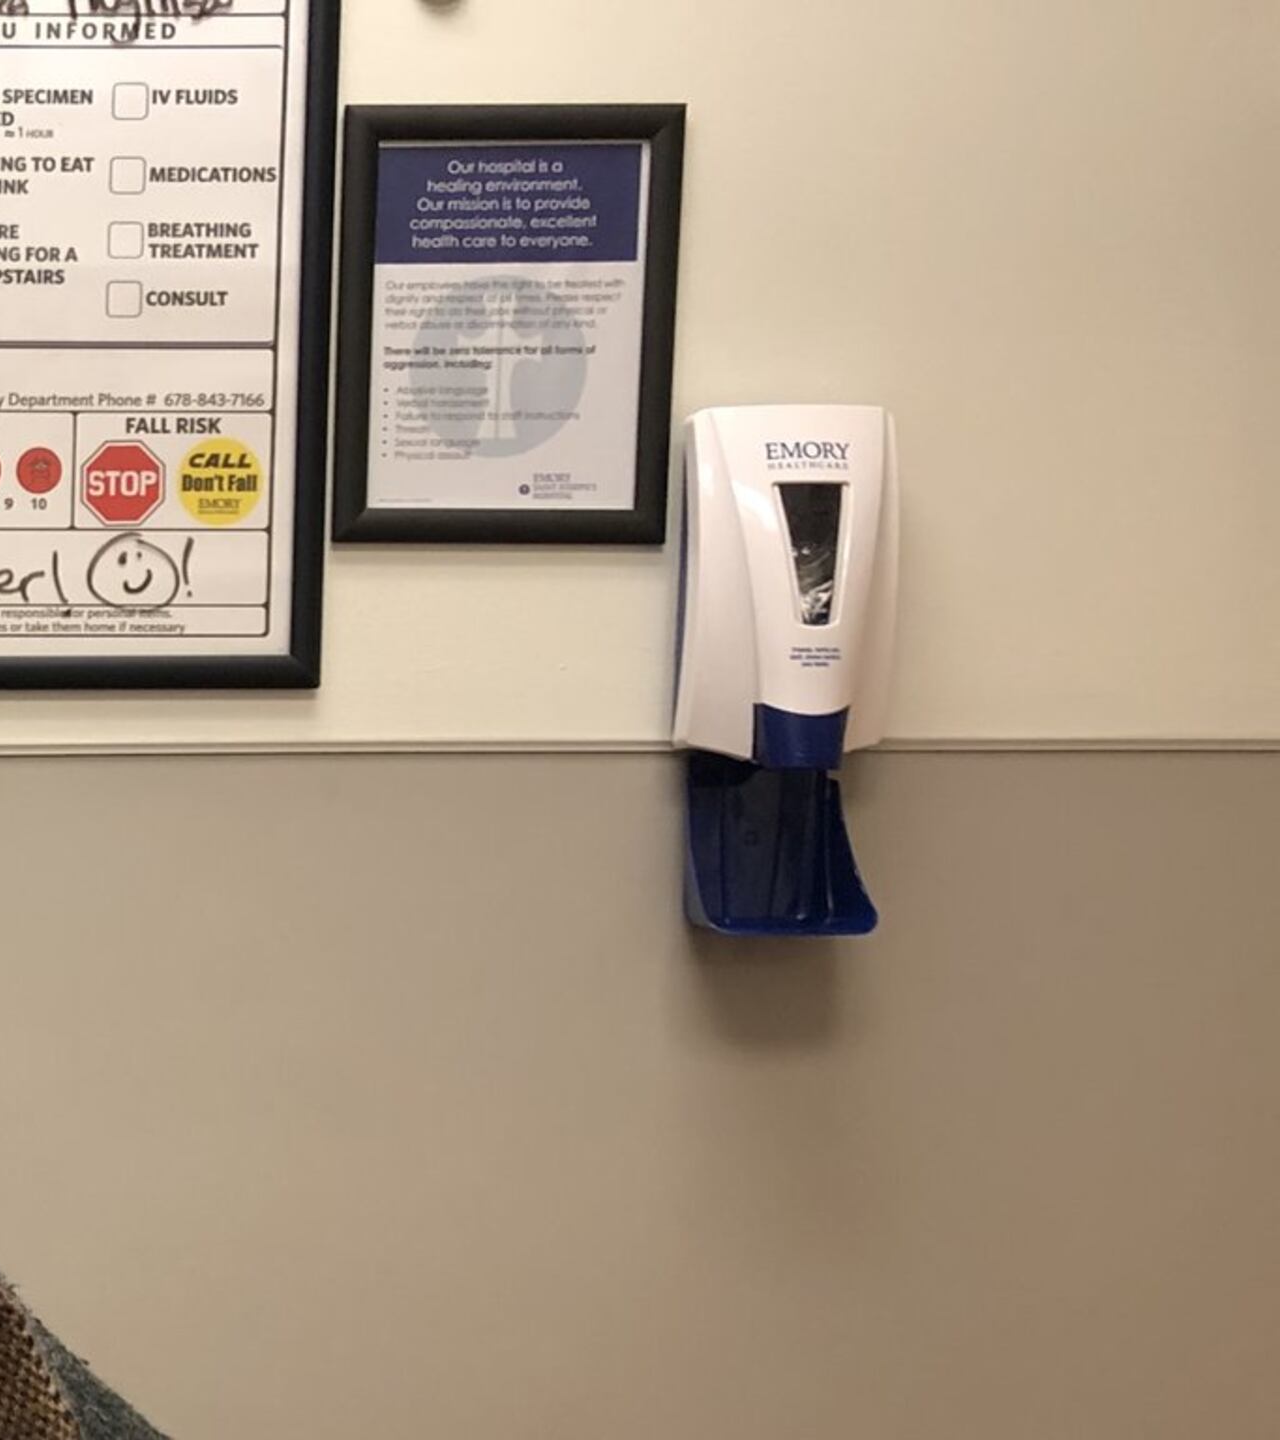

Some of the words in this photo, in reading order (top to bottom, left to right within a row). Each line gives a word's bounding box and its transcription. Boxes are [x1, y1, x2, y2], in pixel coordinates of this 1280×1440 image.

[35, 22, 176, 40] INFORMED
[2, 88, 94, 105] SPECIMEN
[152, 89, 171, 105] IV
[175, 89, 238, 105] FLUIDS
[18, 126, 23, 138] 1
[26, 129, 54, 138] HOUR
[31, 156, 56, 172] TO
[60, 157, 95, 172] EAT
[447, 160, 475, 174] Our
[478, 159, 536, 176] hospital
[538, 160, 548, 173] is
[551, 161, 563, 173] a
[149, 167, 277, 182] MEDICATIONS
[426, 179, 483, 196] healing
[484, 179, 583, 193] environment.
[416, 197, 444, 212] Our
[446, 197, 500, 211] mission
[502, 197, 513, 211] is
[515, 197, 532, 211] to
[534, 196, 592, 212] provide
[147, 222, 252, 238] BREATHING
[408, 216, 528, 232] compassionate,
[529, 215, 598, 228] excellent
[411, 235, 460, 249] health
[461, 236, 497, 248] care
[500, 235, 517, 248] to
[518, 235, 593, 249] everyone.
[25, 246, 61, 262] FOR
[65, 247, 78, 262] A
[148, 243, 259, 258] TREATMENT
[146, 290, 229, 306] CONSULT
[8, 392, 94, 409] Department
[98, 393, 142, 407] Phone
[146, 394, 157, 407] #
[164, 393, 265, 408] 678-843-7166
[125, 417, 170, 433] FALL
[175, 417, 222, 434] RISK
[764, 441, 850, 461] EMORY
[188, 453, 252, 469] CALL
[766, 461, 849, 470] HEALTHCARE
[89, 470, 158, 497] STOP
[181, 474, 225, 492] Don't
[227, 474, 258, 493] Fall
[4, 497, 14, 510] 9
[32, 497, 47, 510] 10
[10, 624, 23, 633] or
[25, 622, 49, 633] take
[52, 622, 82, 633] them
[84, 622, 116, 633] home
[118, 622, 127, 633] if
[129, 623, 186, 635] necessary
